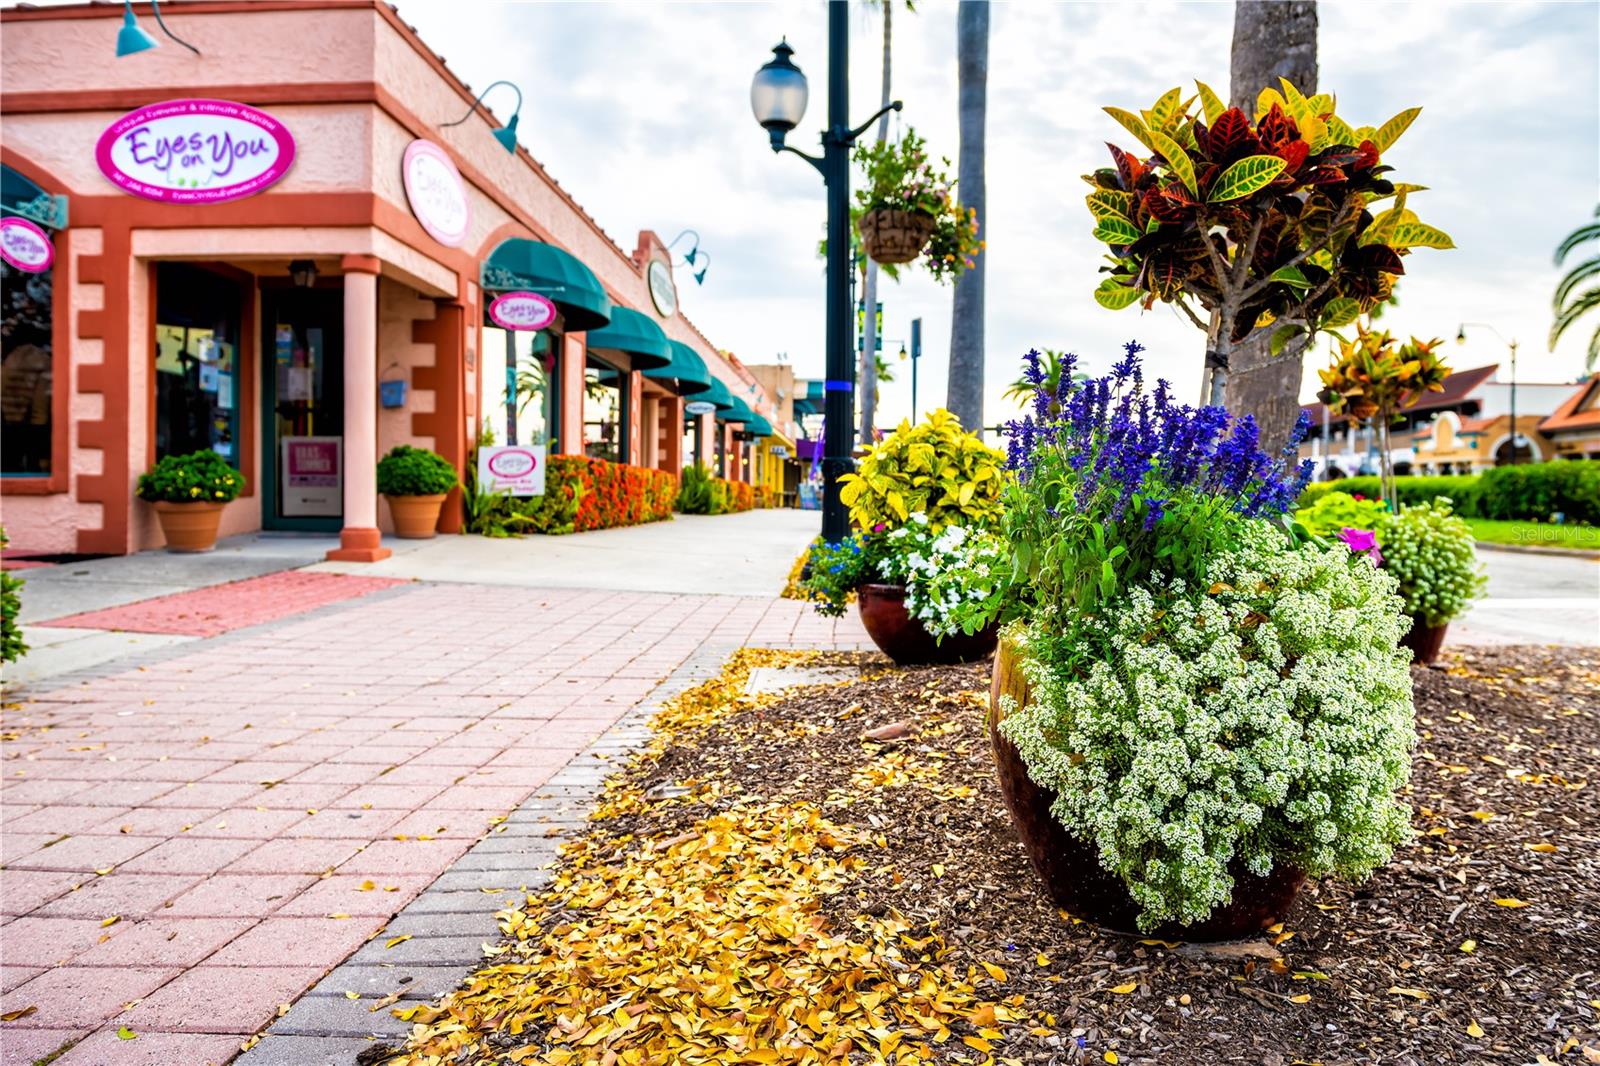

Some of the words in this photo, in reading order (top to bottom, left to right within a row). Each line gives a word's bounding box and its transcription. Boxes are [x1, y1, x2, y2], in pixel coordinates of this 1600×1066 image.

[146, 105, 186, 118] Eyewear
[189, 104, 197, 112] &
[198, 104, 238, 116] Intimate
[240, 109, 275, 130] Apparel
[125, 126, 203, 171] Eyes
[181, 153, 204, 168] on
[206, 131, 269, 177] You
[500, 301, 525, 318] Eyes
[525, 304, 546, 321] You
